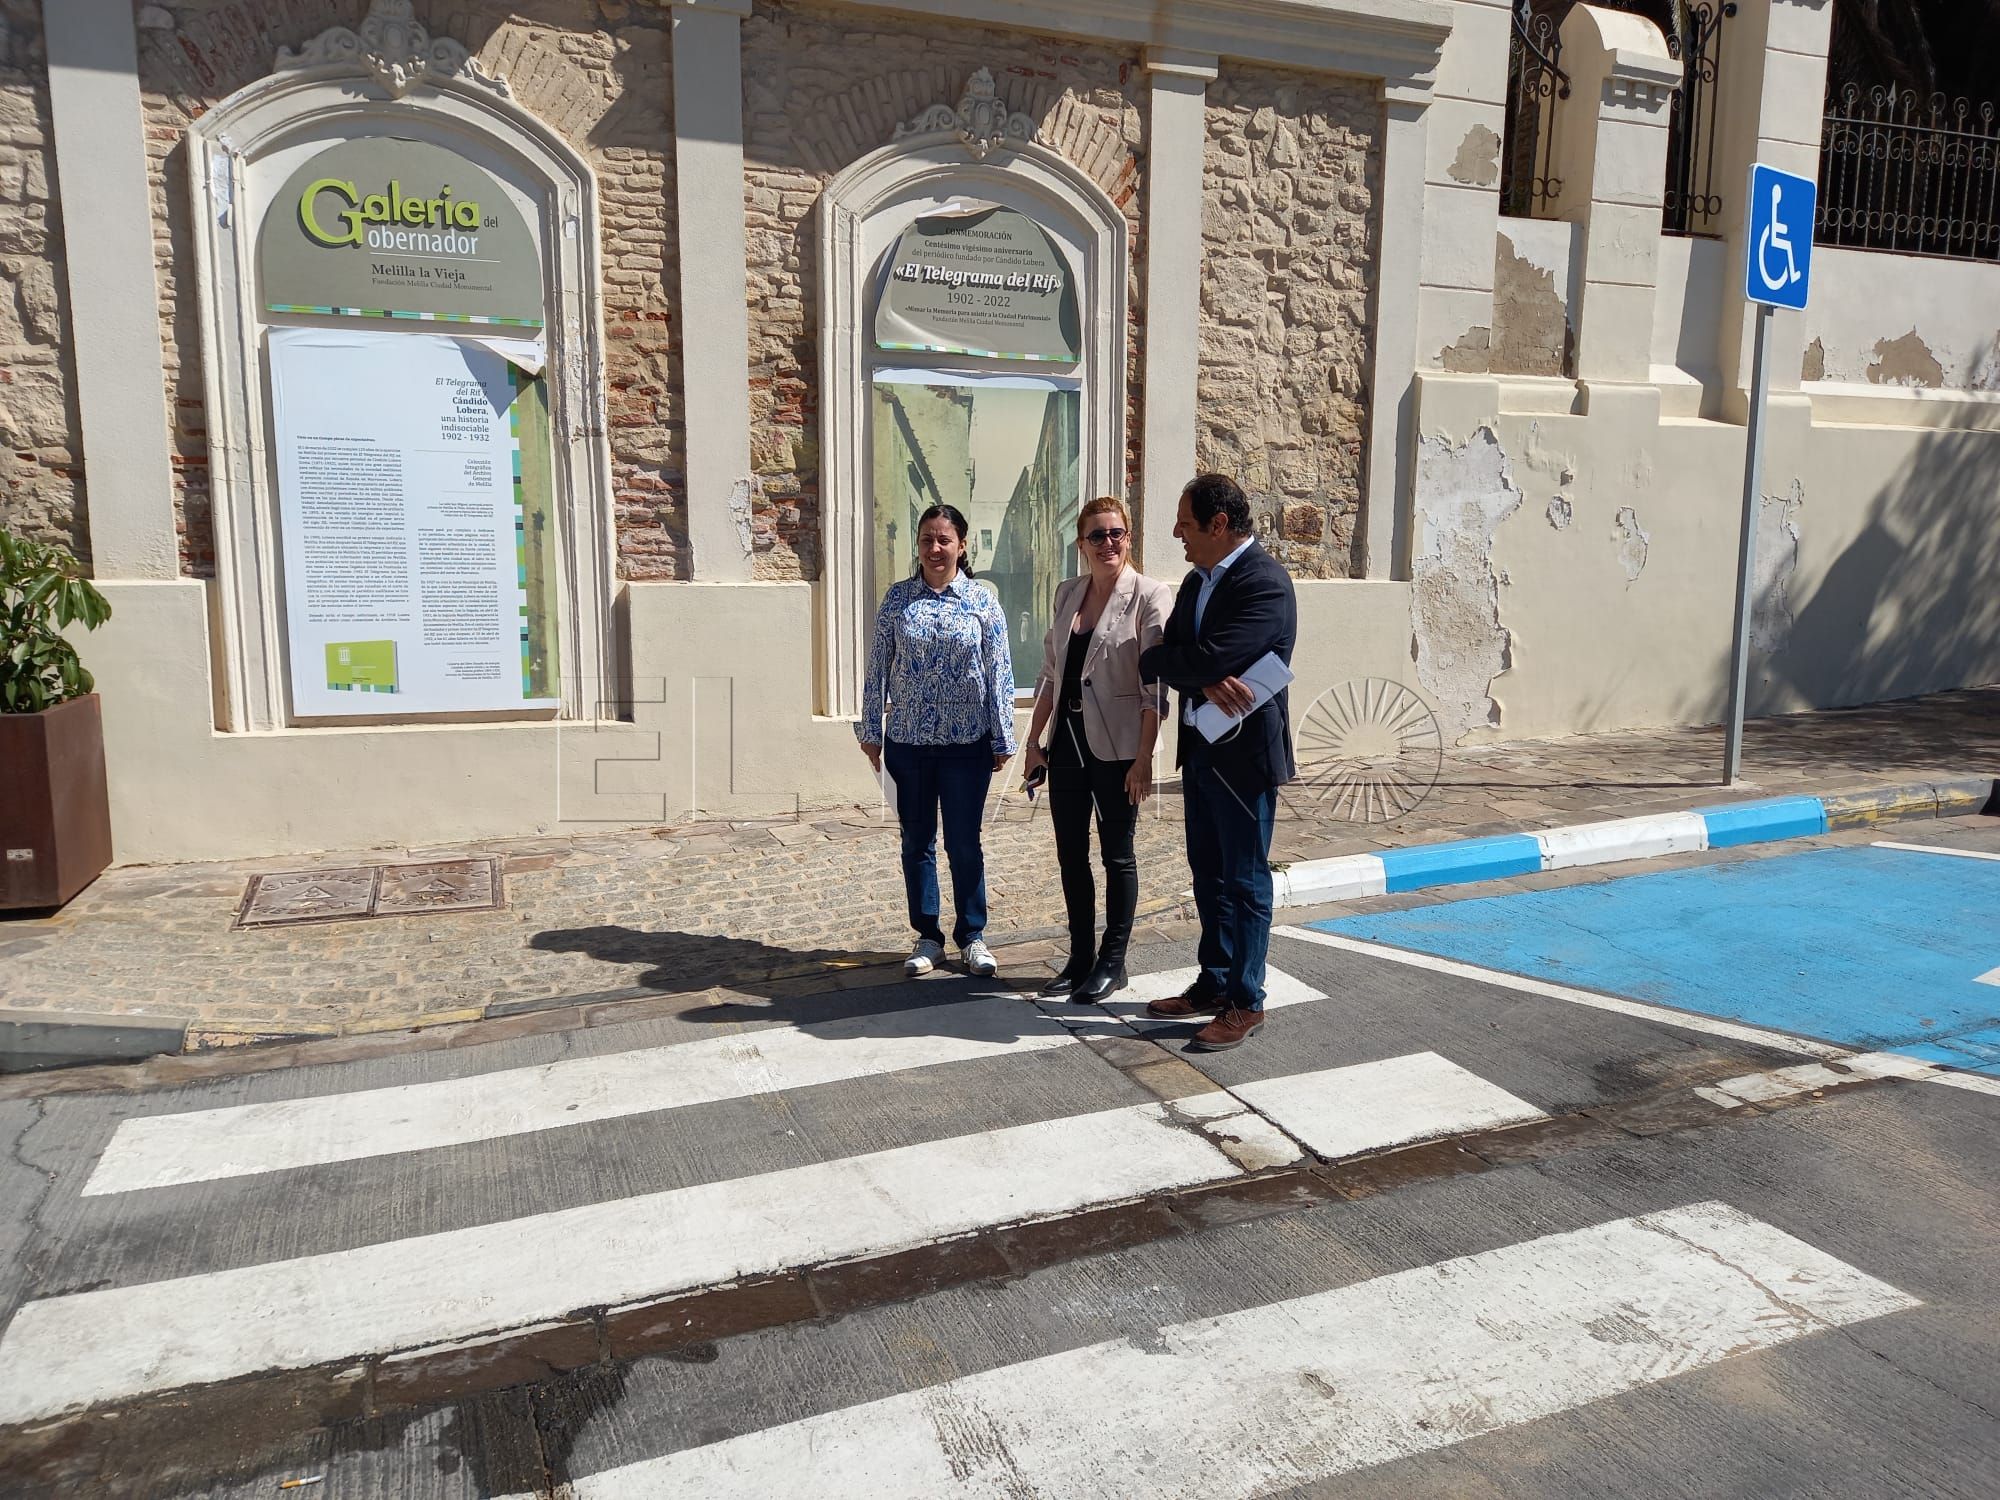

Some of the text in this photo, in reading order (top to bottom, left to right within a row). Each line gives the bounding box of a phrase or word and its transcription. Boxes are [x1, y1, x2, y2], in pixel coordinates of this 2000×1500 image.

[482, 215, 499, 228] del
[945, 228, 1013, 241] CONMEMORACIÓN
[924, 240, 1033, 256] Centésimo vigésimo aniversario
[911, 248, 1046, 267] del periódico fundado por Cándido Lobera
[371, 264, 466, 282] Melilla la Vieja
[922, 265, 1003, 289] Telegrama
[1004, 271, 1030, 290] del
[371, 277, 493, 291] Fundación Melilla Ciudad Monumental
[947, 292, 974, 305] 1902
[983, 295, 1011, 308] 2022
[932, 307, 957, 316] Memoria
[957, 309, 970, 317] para
[998, 311, 1016, 320] Ciudad
[435, 377, 487, 388] El Telegrama
[452, 396, 488, 405] Cándido
[482, 390, 488, 398] y
[458, 415, 489, 423] historia
[441, 424, 490, 432] indisociable
[442, 432, 462, 441] 1902
[470, 433, 490, 442] 1932
